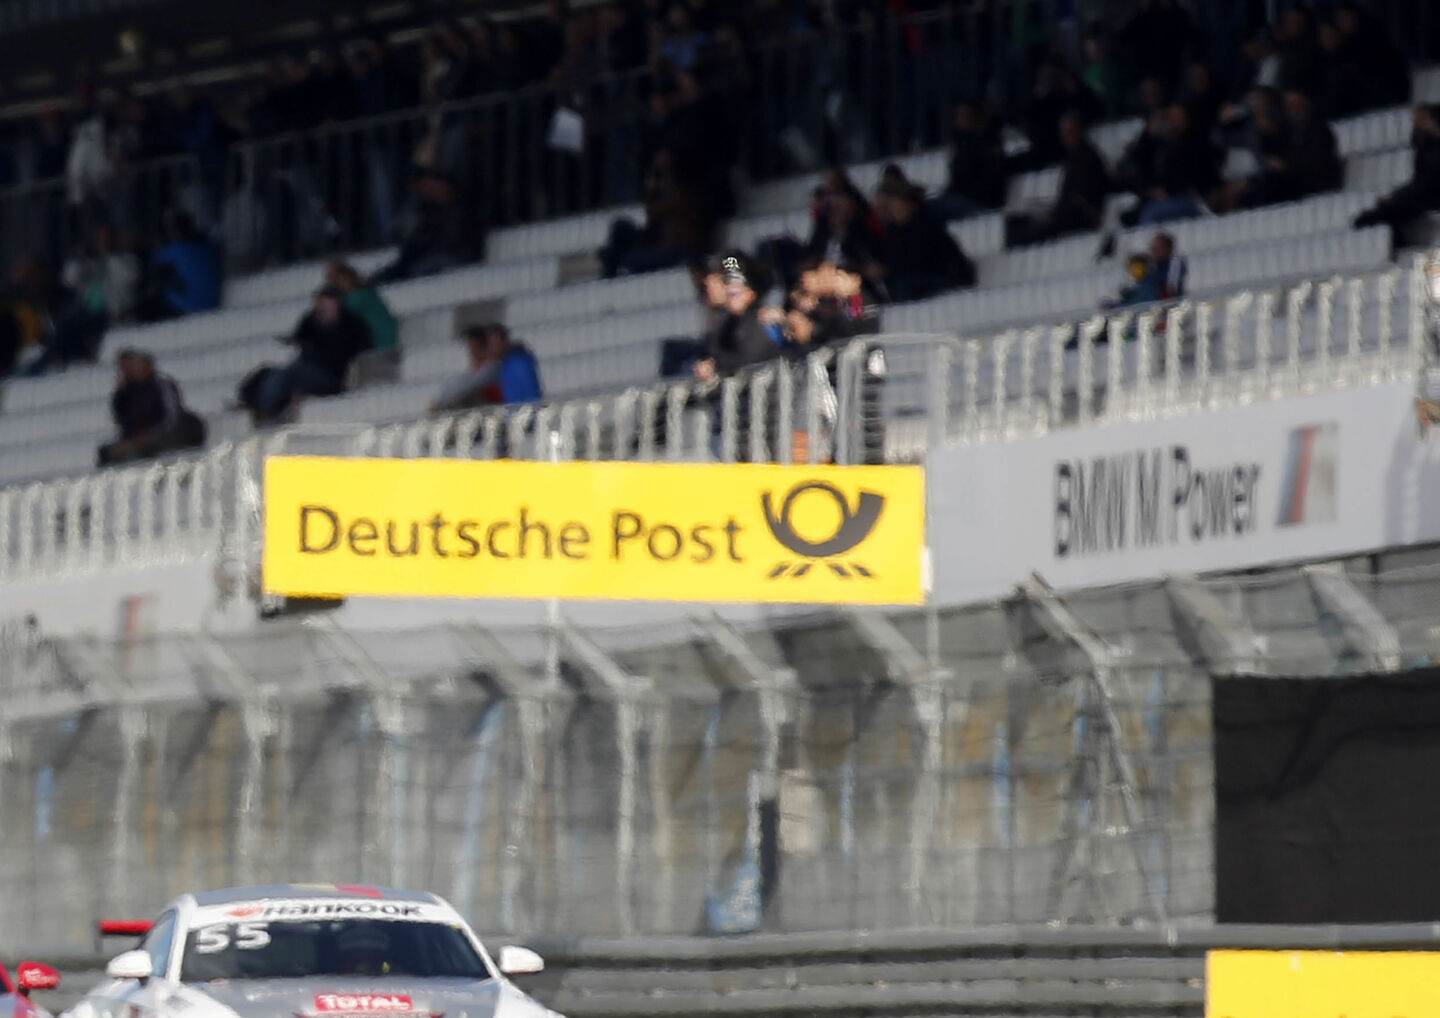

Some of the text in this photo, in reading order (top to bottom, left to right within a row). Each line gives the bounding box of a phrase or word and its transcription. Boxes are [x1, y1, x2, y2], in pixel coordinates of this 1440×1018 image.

[1055, 459, 1130, 558] BMW
[1171, 444, 1261, 543] Power
[298, 504, 746, 563] Deutsche Post
[195, 921, 272, 955] 55
[318, 992, 411, 1011] TOTAL
